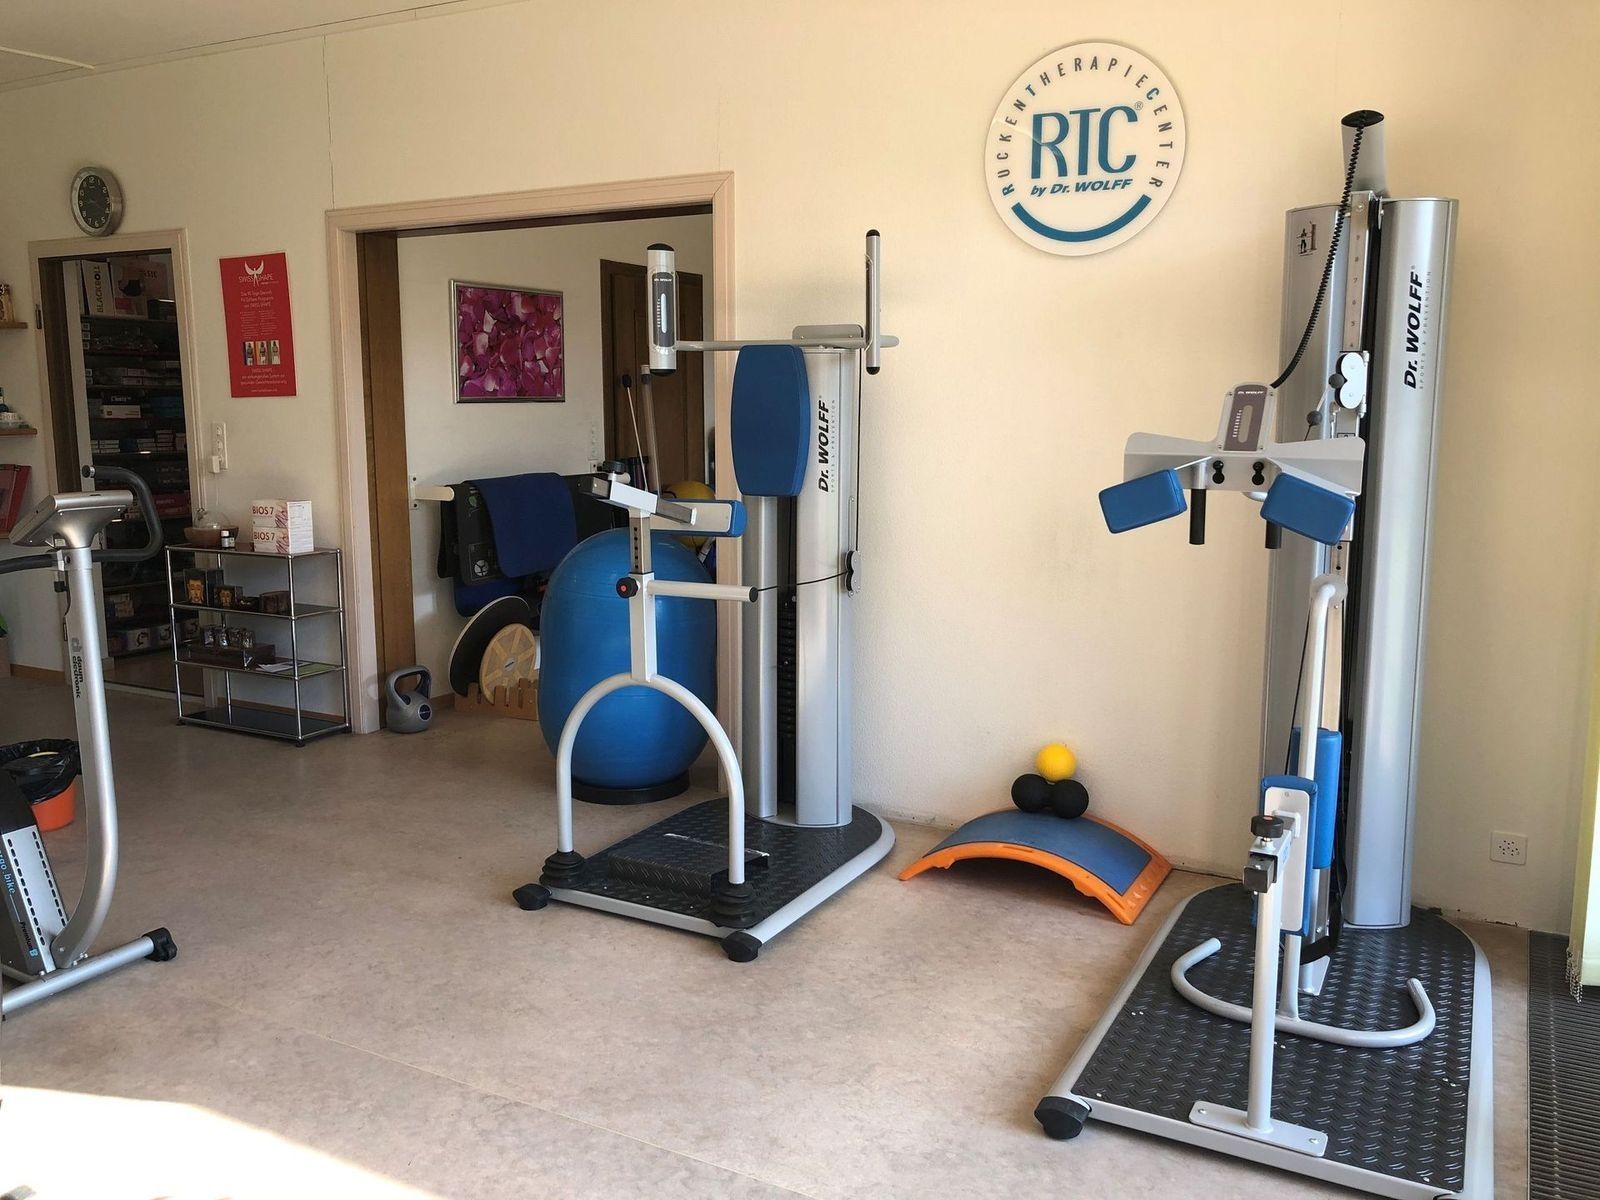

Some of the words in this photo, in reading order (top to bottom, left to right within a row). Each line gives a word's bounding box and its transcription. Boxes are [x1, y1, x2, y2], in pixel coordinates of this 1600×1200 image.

[1030, 184, 1047, 198] by
[1050, 183, 1070, 194] Dr.
[1075, 178, 1133, 193] WOLFF
[238, 275, 254, 284] SWISS
[1406, 271, 1423, 353] WOLFF
[1404, 360, 1418, 389] Dr.
[819, 400, 829, 464] WOLFF
[819, 469, 829, 493] Dr.
[252, 505, 269, 515] BIOS
[269, 507, 274, 515] 7
[253, 531, 270, 541] BIOS
[270, 532, 276, 541] 7
[72, 656, 81, 698] electronic
